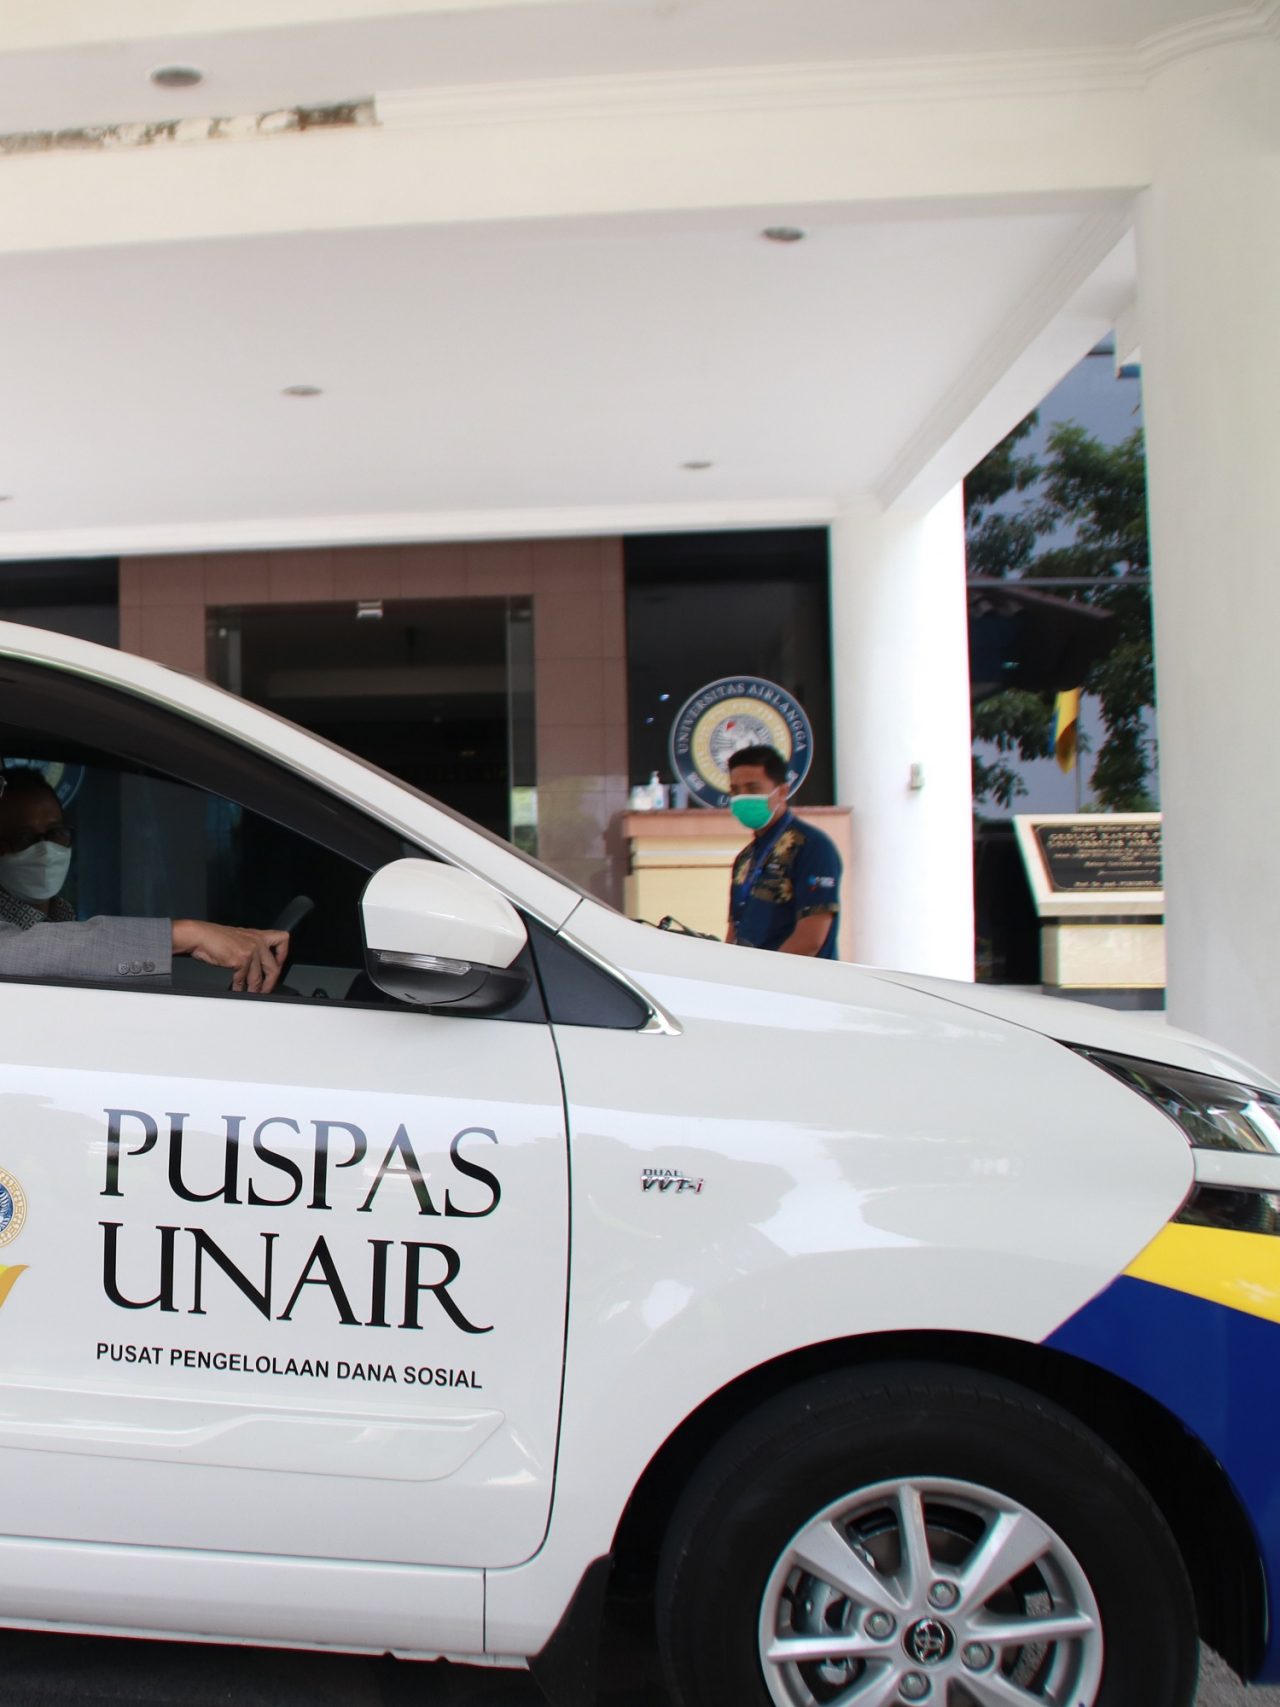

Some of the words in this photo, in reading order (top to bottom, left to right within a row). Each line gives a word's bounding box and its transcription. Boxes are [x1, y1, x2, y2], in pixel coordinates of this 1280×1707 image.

[678, 683, 745, 754] UNIVERSITAS
[747, 684, 807, 752] AIRLANGGA
[100, 1108, 502, 1218] PUSPAS
[643, 1168, 682, 1177] DUAL
[98, 1221, 494, 1334] UNAIR
[96, 1343, 163, 1365] PUSAT
[170, 1349, 329, 1379] PENGELOLAAN
[337, 1361, 397, 1383] DANA
[403, 1366, 483, 1389] SOSIAL
